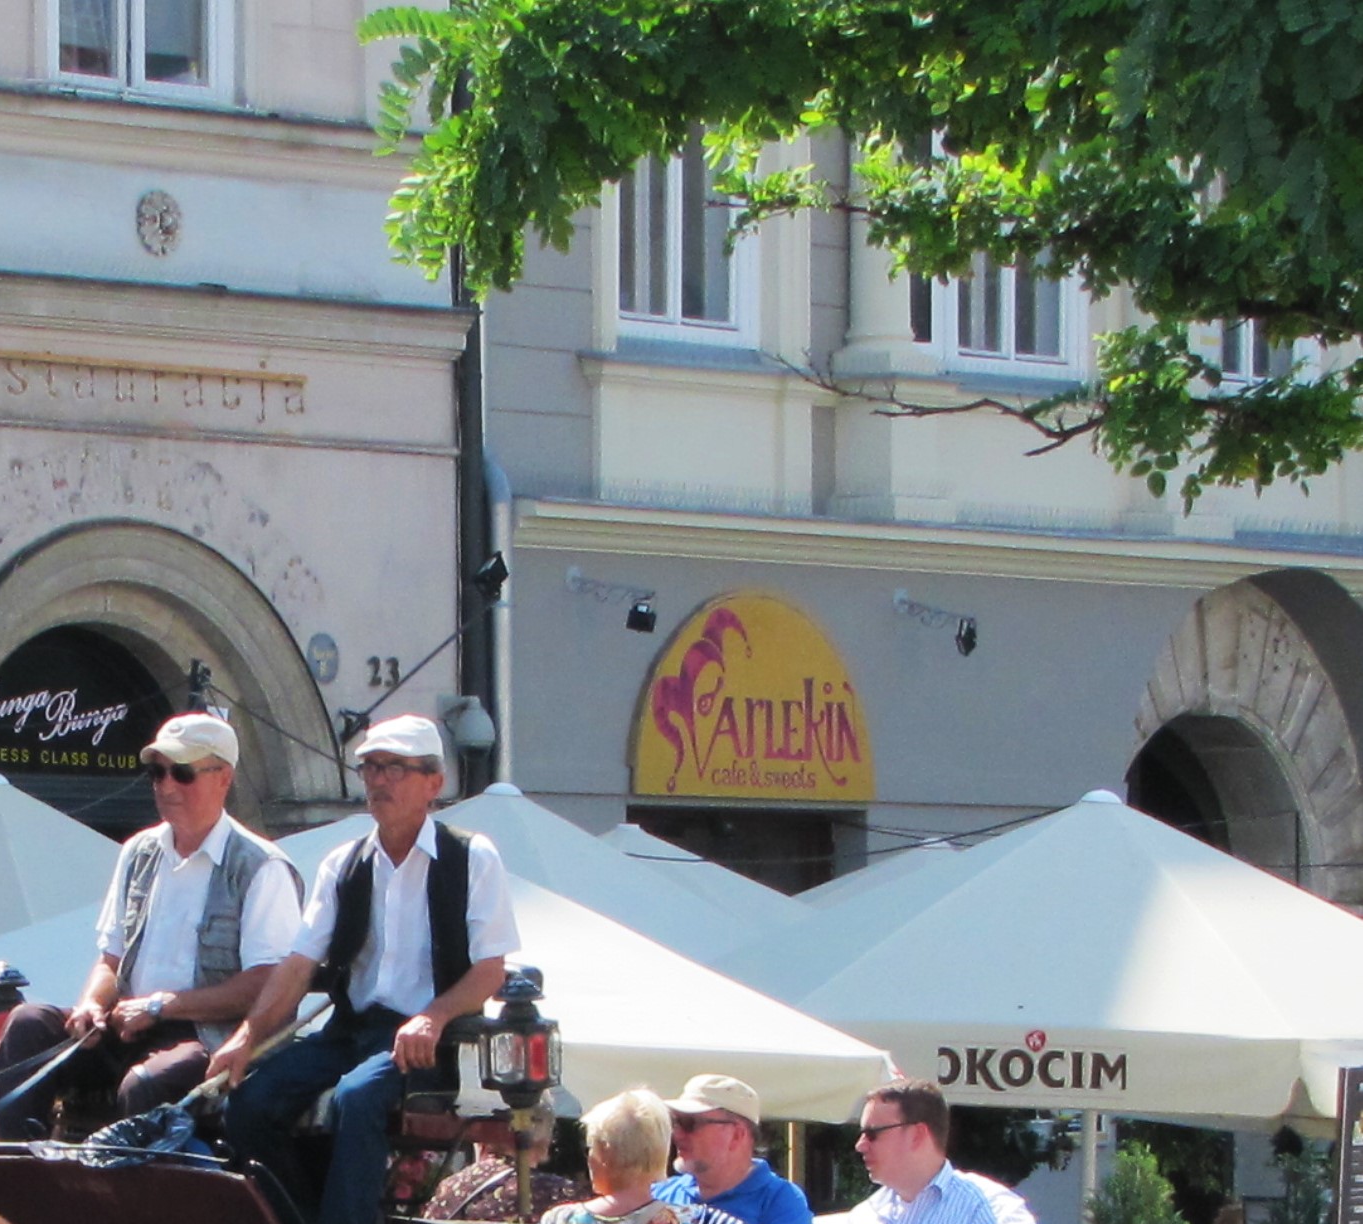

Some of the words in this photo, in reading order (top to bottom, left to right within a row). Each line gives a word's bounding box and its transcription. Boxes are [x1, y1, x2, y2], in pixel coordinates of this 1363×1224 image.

[367, 656, 400, 687] 23
[39, 679, 128, 745] Bunga
[40, 750, 88, 766] CLASS
[97, 753, 137, 769] CLUB
[712, 760, 746, 786] cafe
[763, 763, 816, 788] sweets
